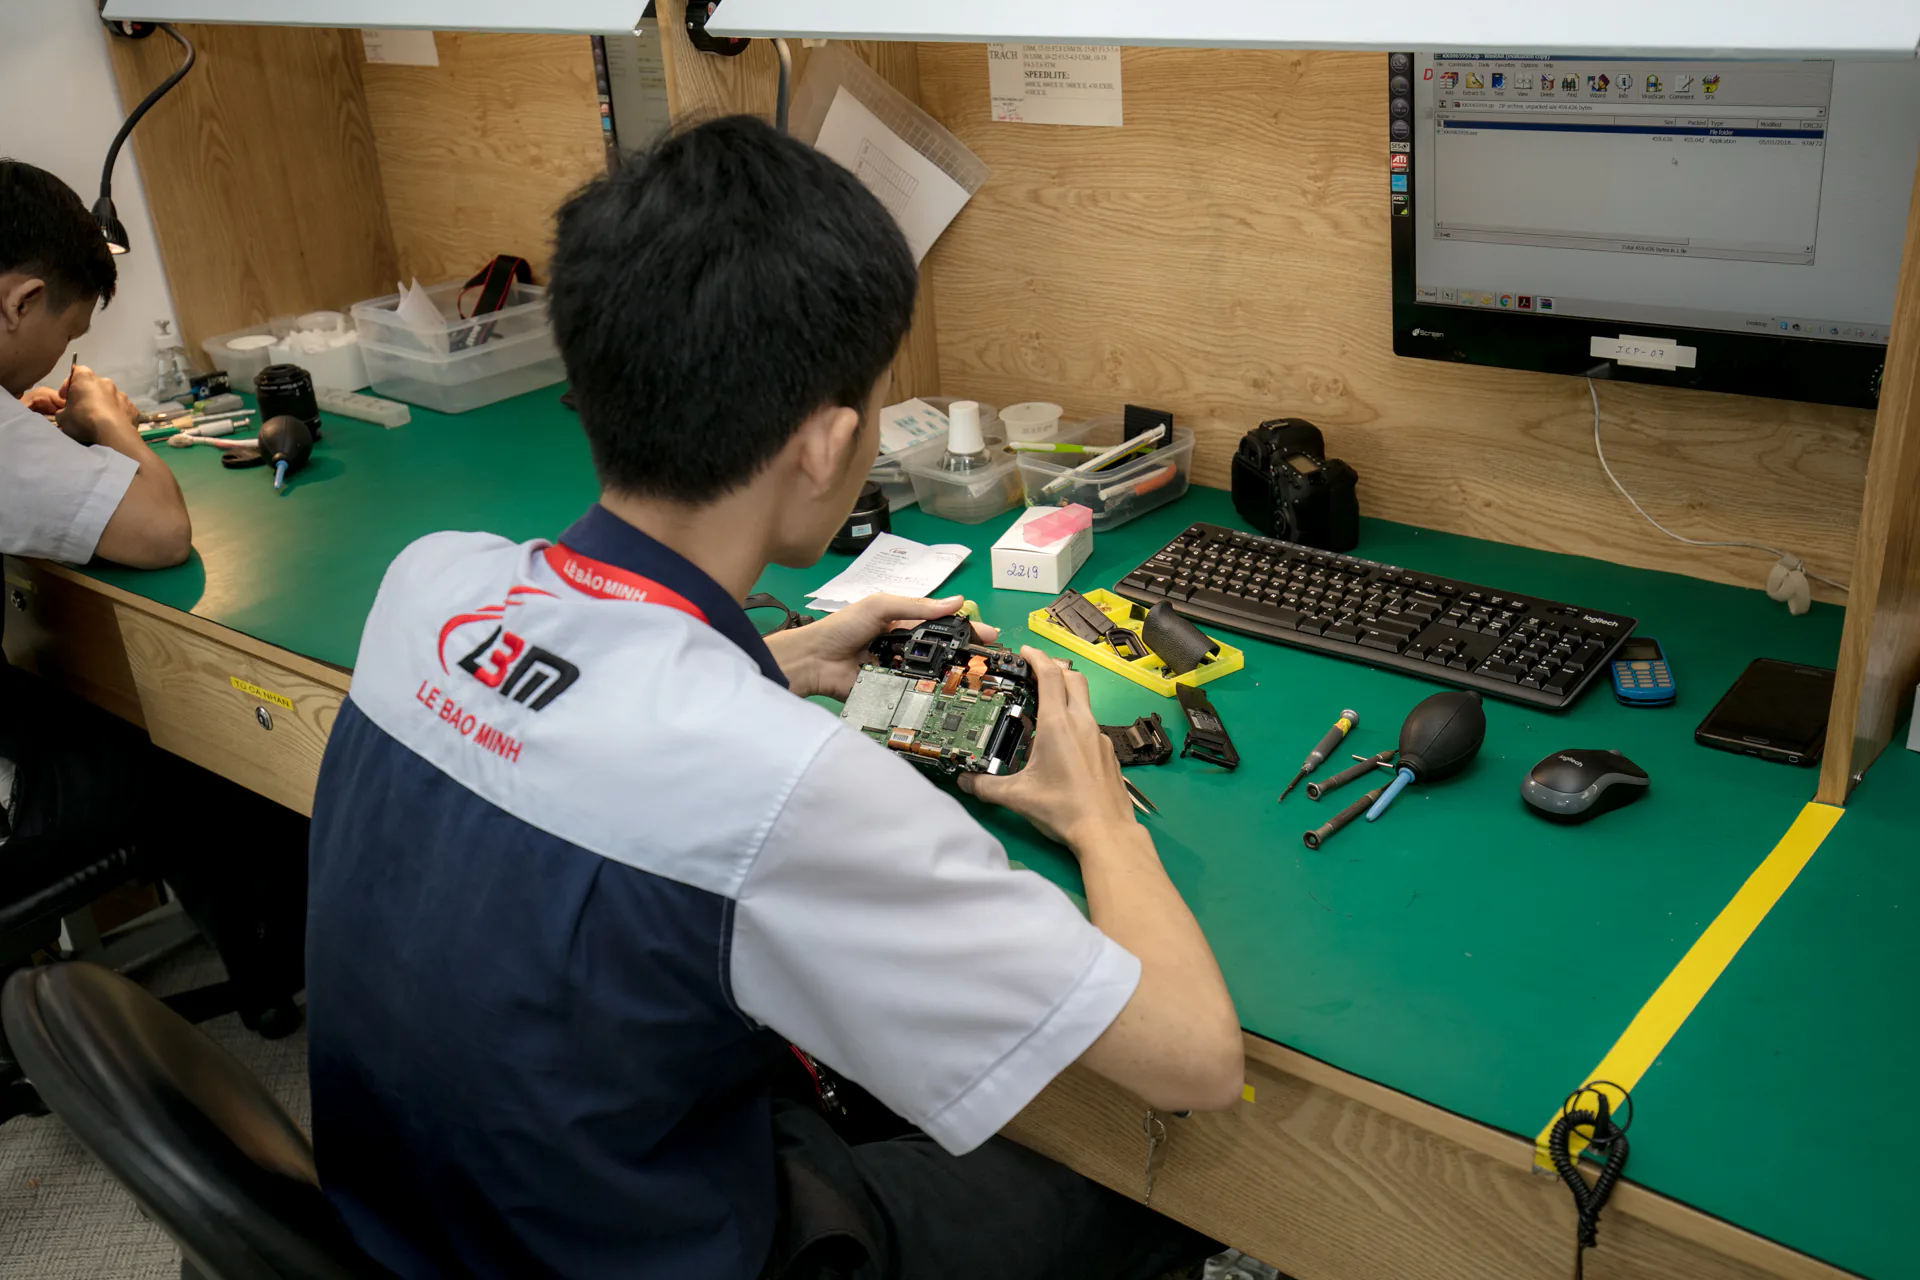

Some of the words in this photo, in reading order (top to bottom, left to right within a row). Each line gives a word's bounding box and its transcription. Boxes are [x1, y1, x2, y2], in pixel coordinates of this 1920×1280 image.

[1025, 71, 1070, 79] SPEEDLITE:
[1007, 563, 1039, 579] 2219
[603, 579, 648, 602] MINH
[1583, 614, 1619, 627] logitech
[472, 722, 523, 763] MINH
